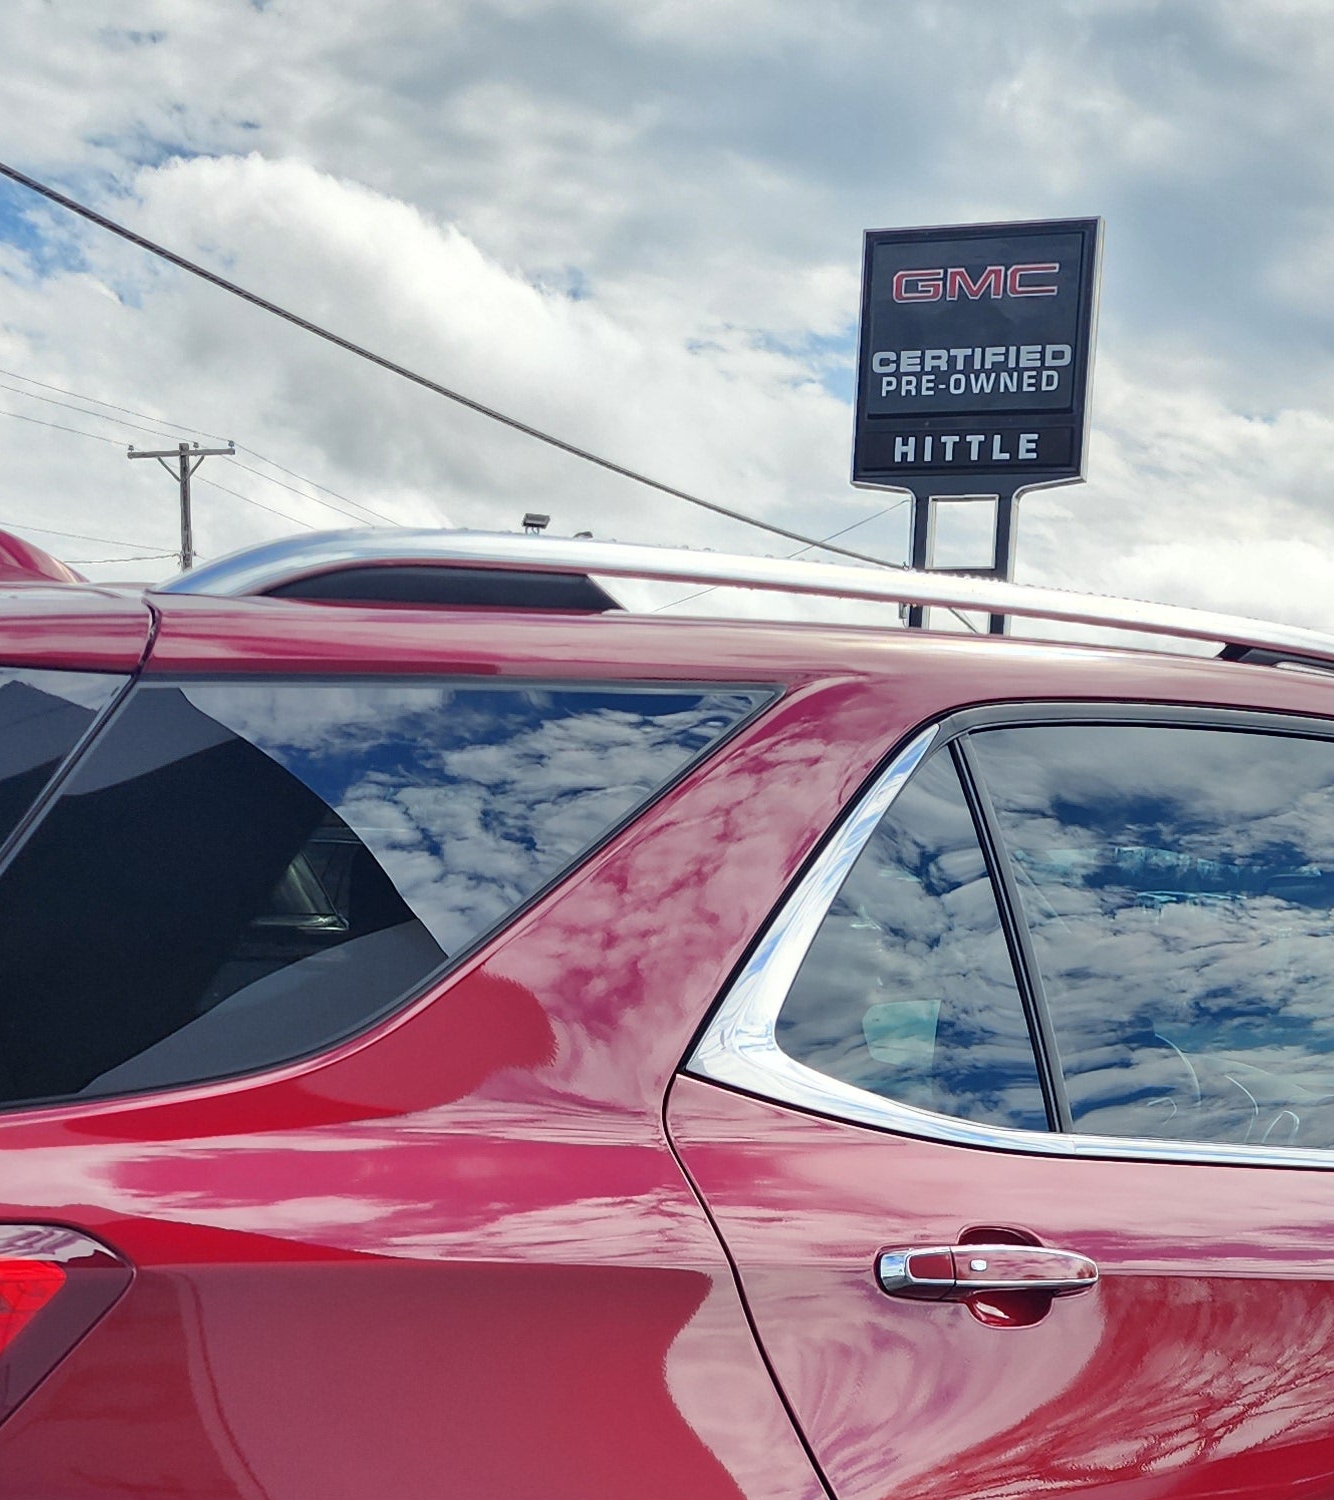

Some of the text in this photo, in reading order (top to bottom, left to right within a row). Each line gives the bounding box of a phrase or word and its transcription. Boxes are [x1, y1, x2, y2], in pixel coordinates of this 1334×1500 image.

[892, 263, 1060, 303] GMC
[872, 344, 1072, 374] CERTIFIED
[881, 370, 1059, 397] PRE-OWNED
[893, 433, 1039, 463] HITTLE
